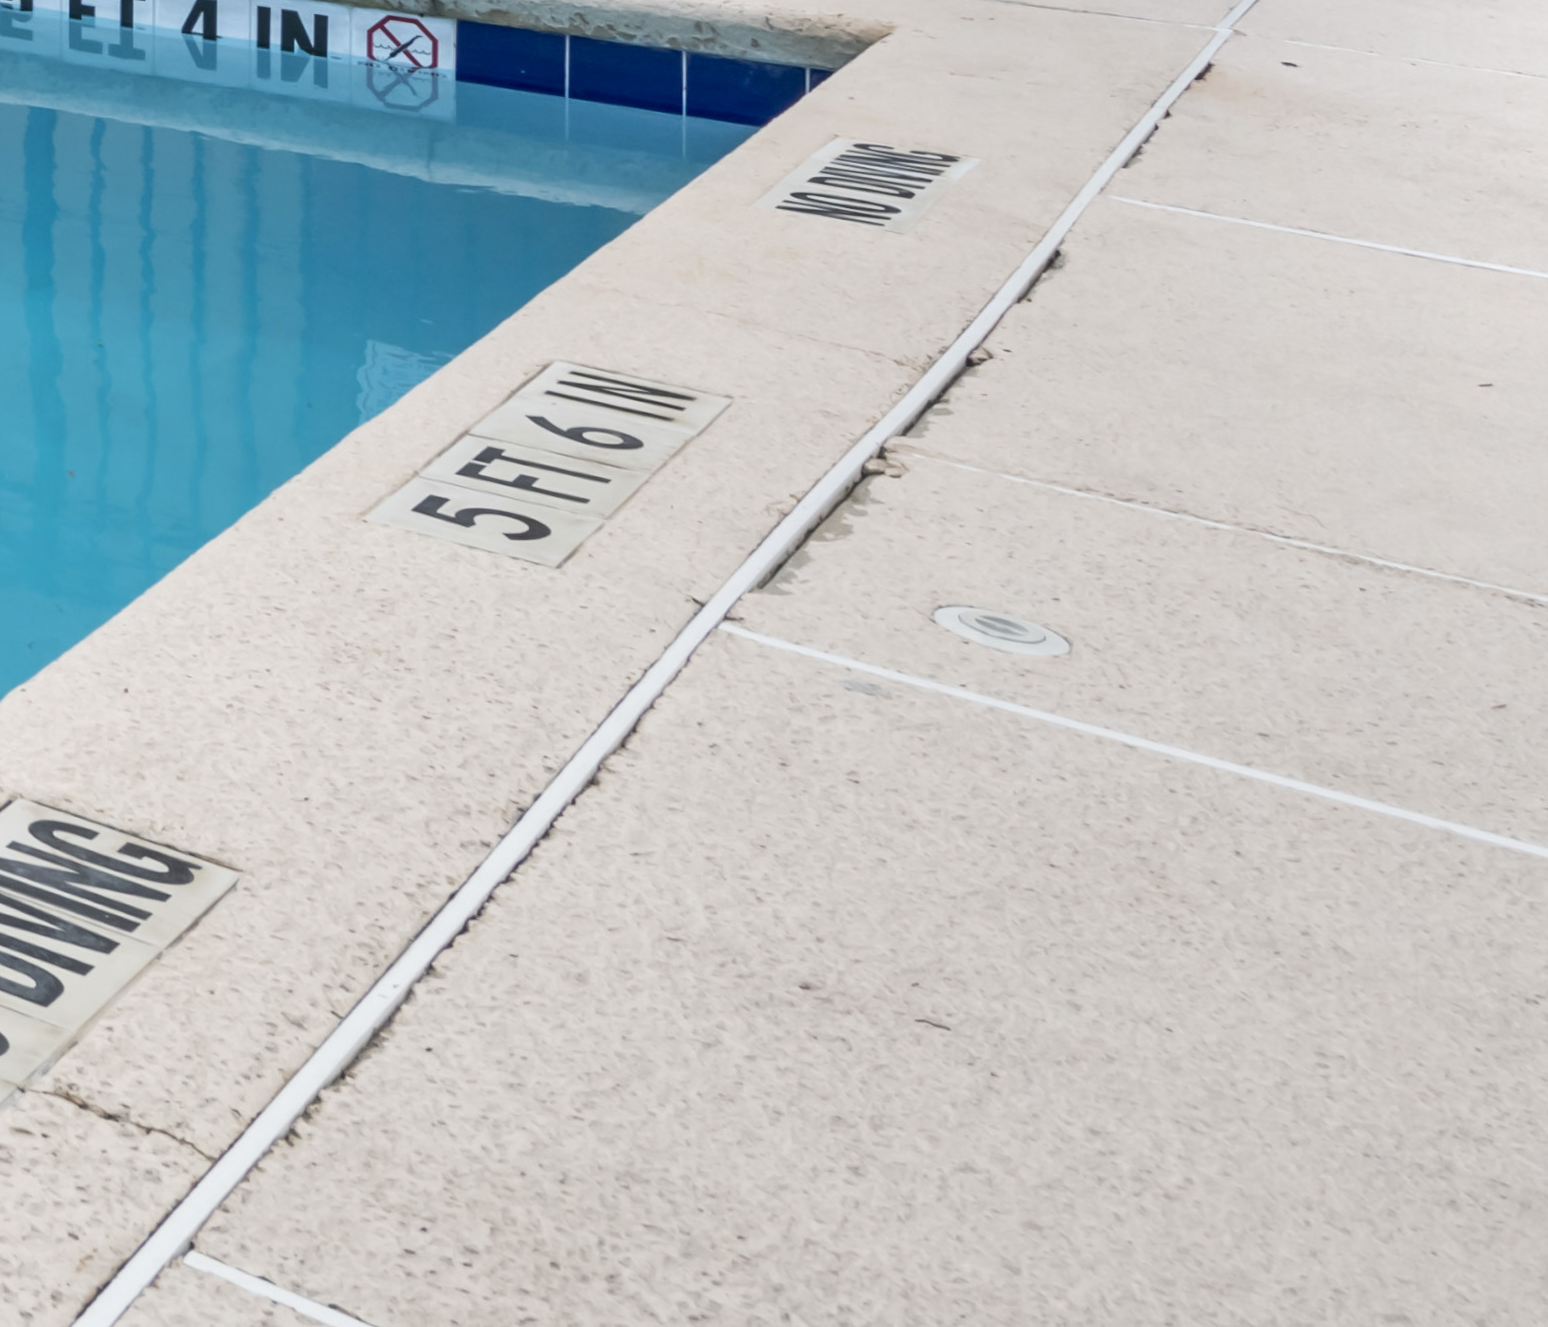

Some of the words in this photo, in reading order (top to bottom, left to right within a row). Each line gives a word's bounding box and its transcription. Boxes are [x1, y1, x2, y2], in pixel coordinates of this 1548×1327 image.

[256, 6, 329, 58] IN
[808, 142, 961, 200] DIVING
[775, 190, 902, 227] NO
[544, 370, 698, 422] IN
[525, 414, 645, 450] 6
[455, 445, 613, 504] FT
[410, 493, 552, 542] 5
